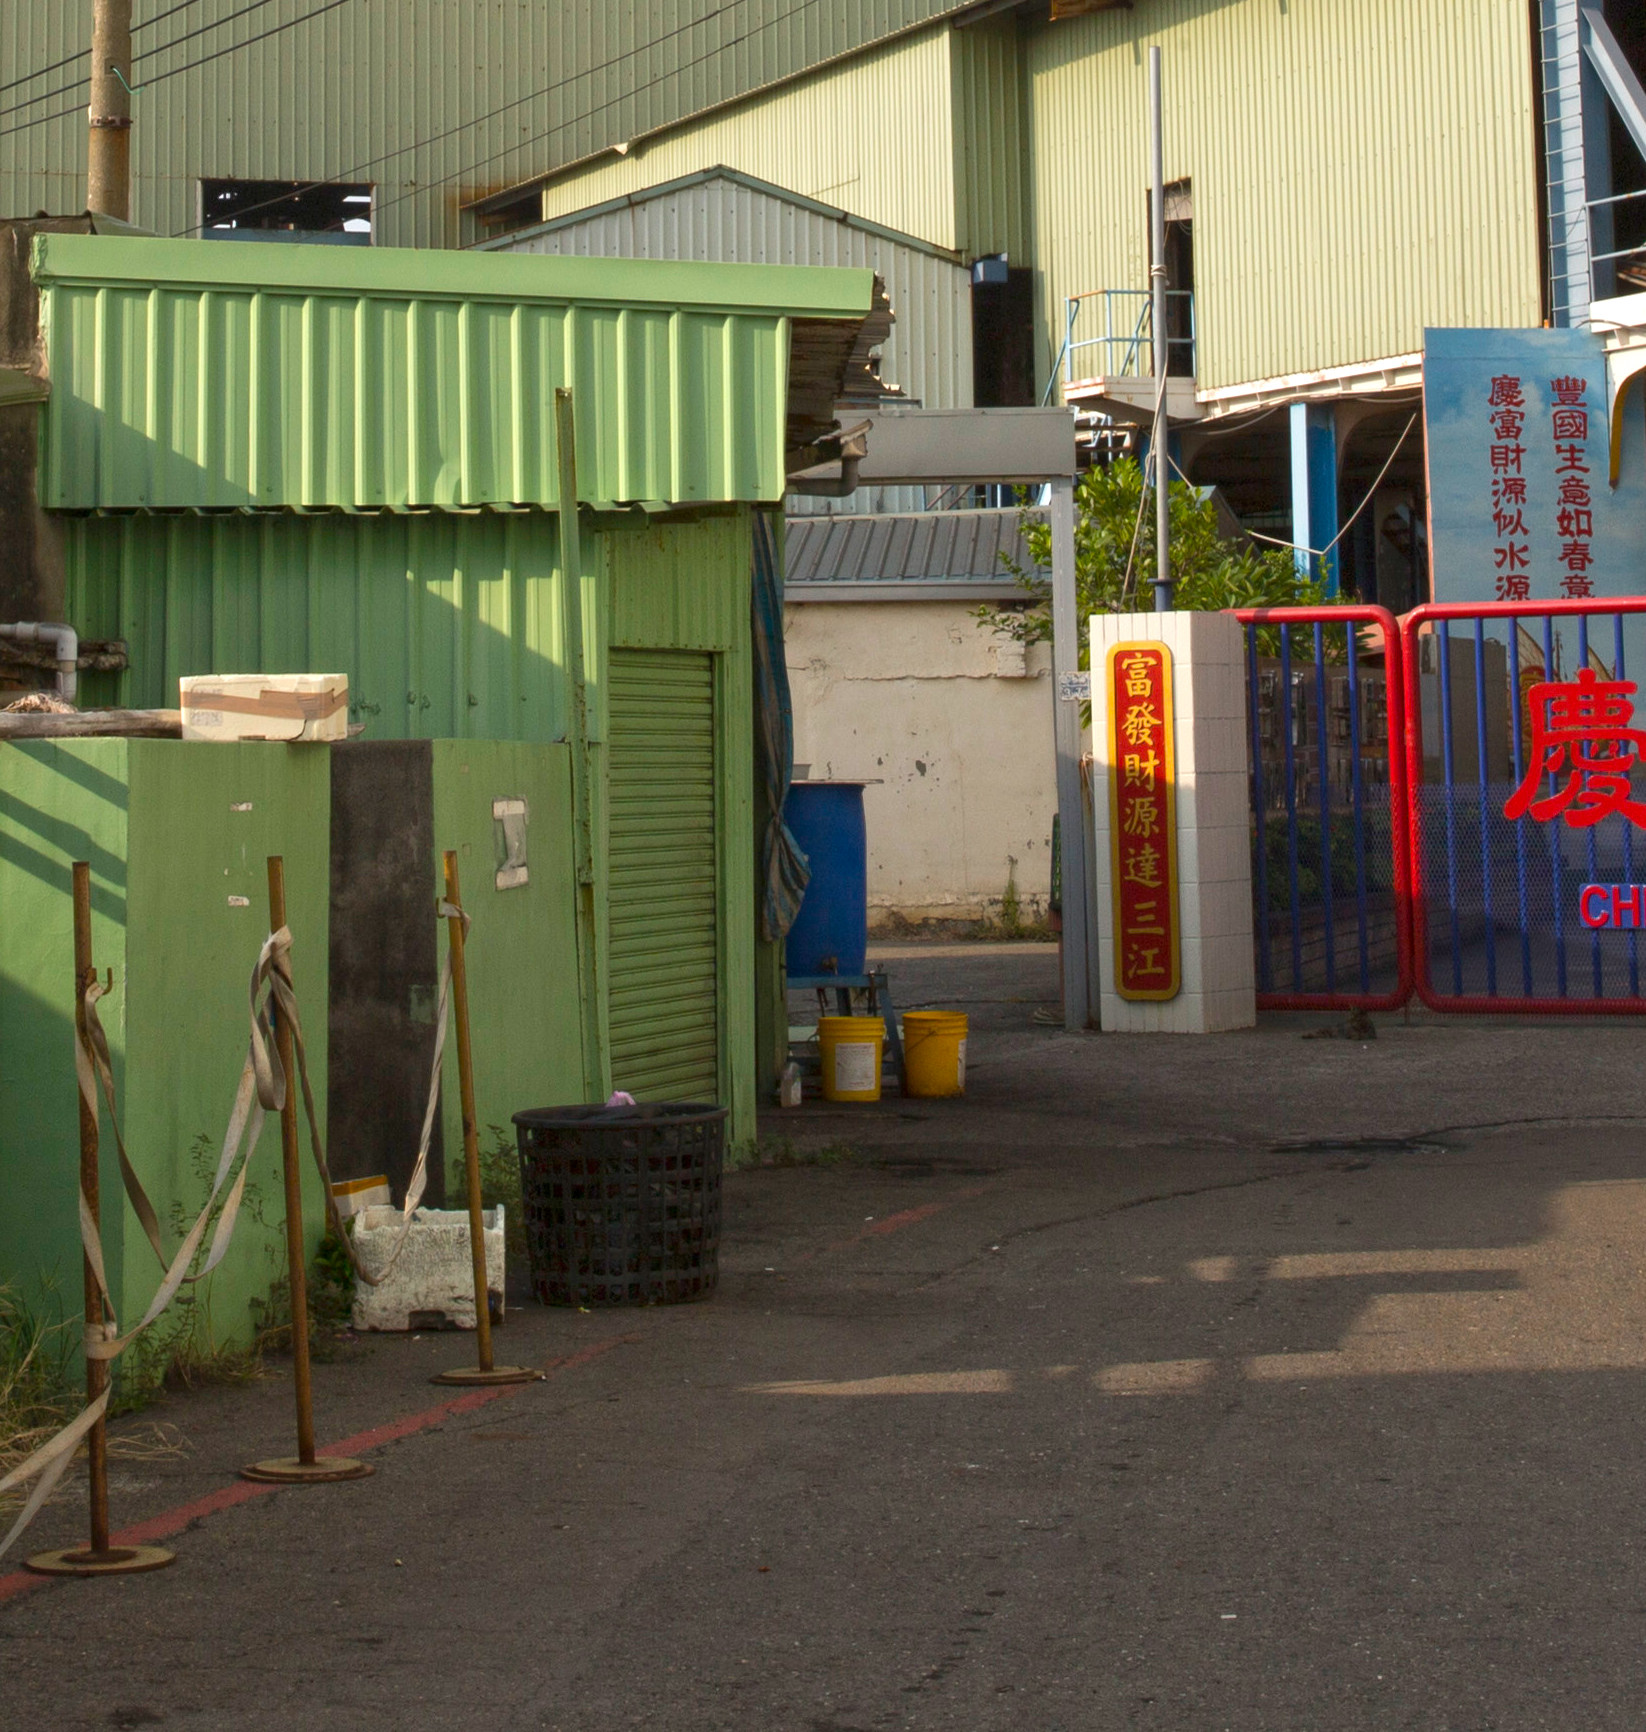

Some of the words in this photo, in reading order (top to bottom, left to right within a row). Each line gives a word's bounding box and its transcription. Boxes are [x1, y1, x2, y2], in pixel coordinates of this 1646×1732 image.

[1487, 374, 1531, 601] 慶富財源似水源
[1121, 651, 1166, 979] 富發財源達三江
